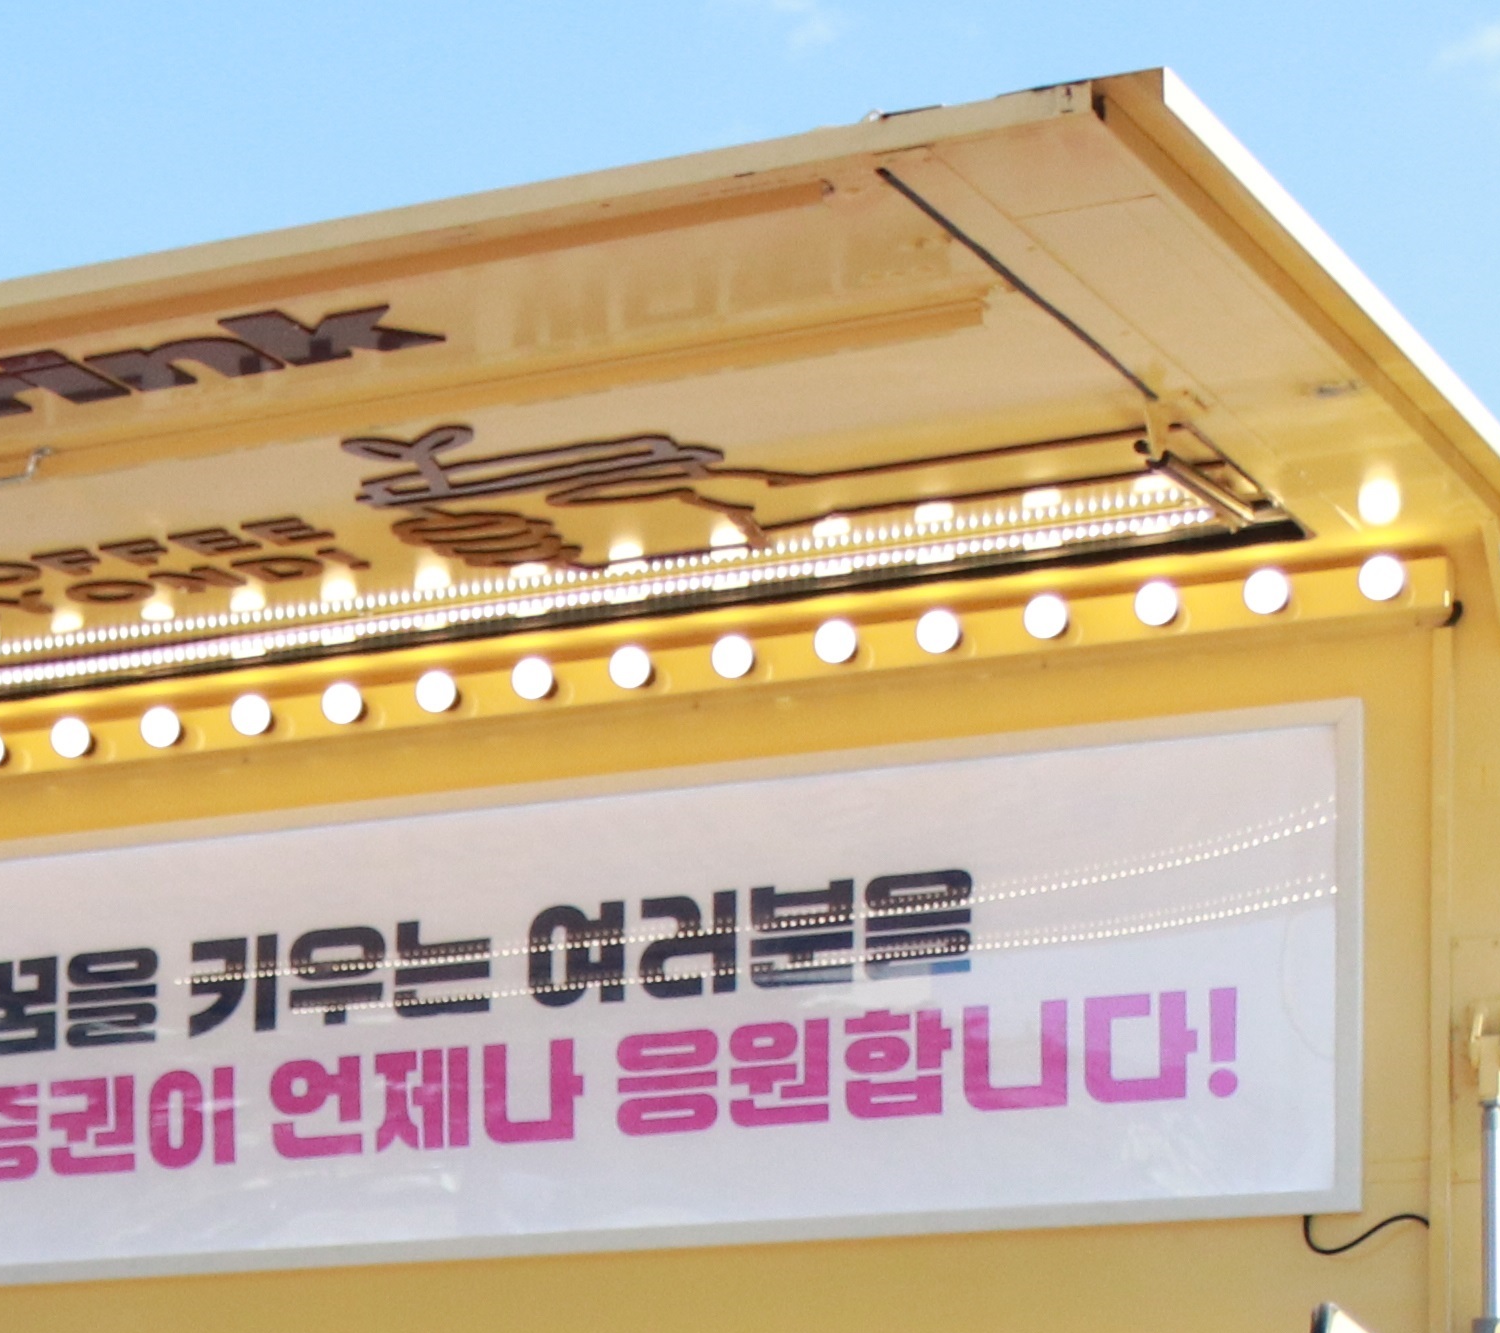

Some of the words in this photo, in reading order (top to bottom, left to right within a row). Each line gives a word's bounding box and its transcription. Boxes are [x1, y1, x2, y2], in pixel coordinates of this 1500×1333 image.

[187, 919, 493, 1039] 키우는
[527, 867, 974, 1008] 여러분을
[269, 1037, 585, 1160] 언제나
[615, 987, 1239, 1138] 응원합니다!
